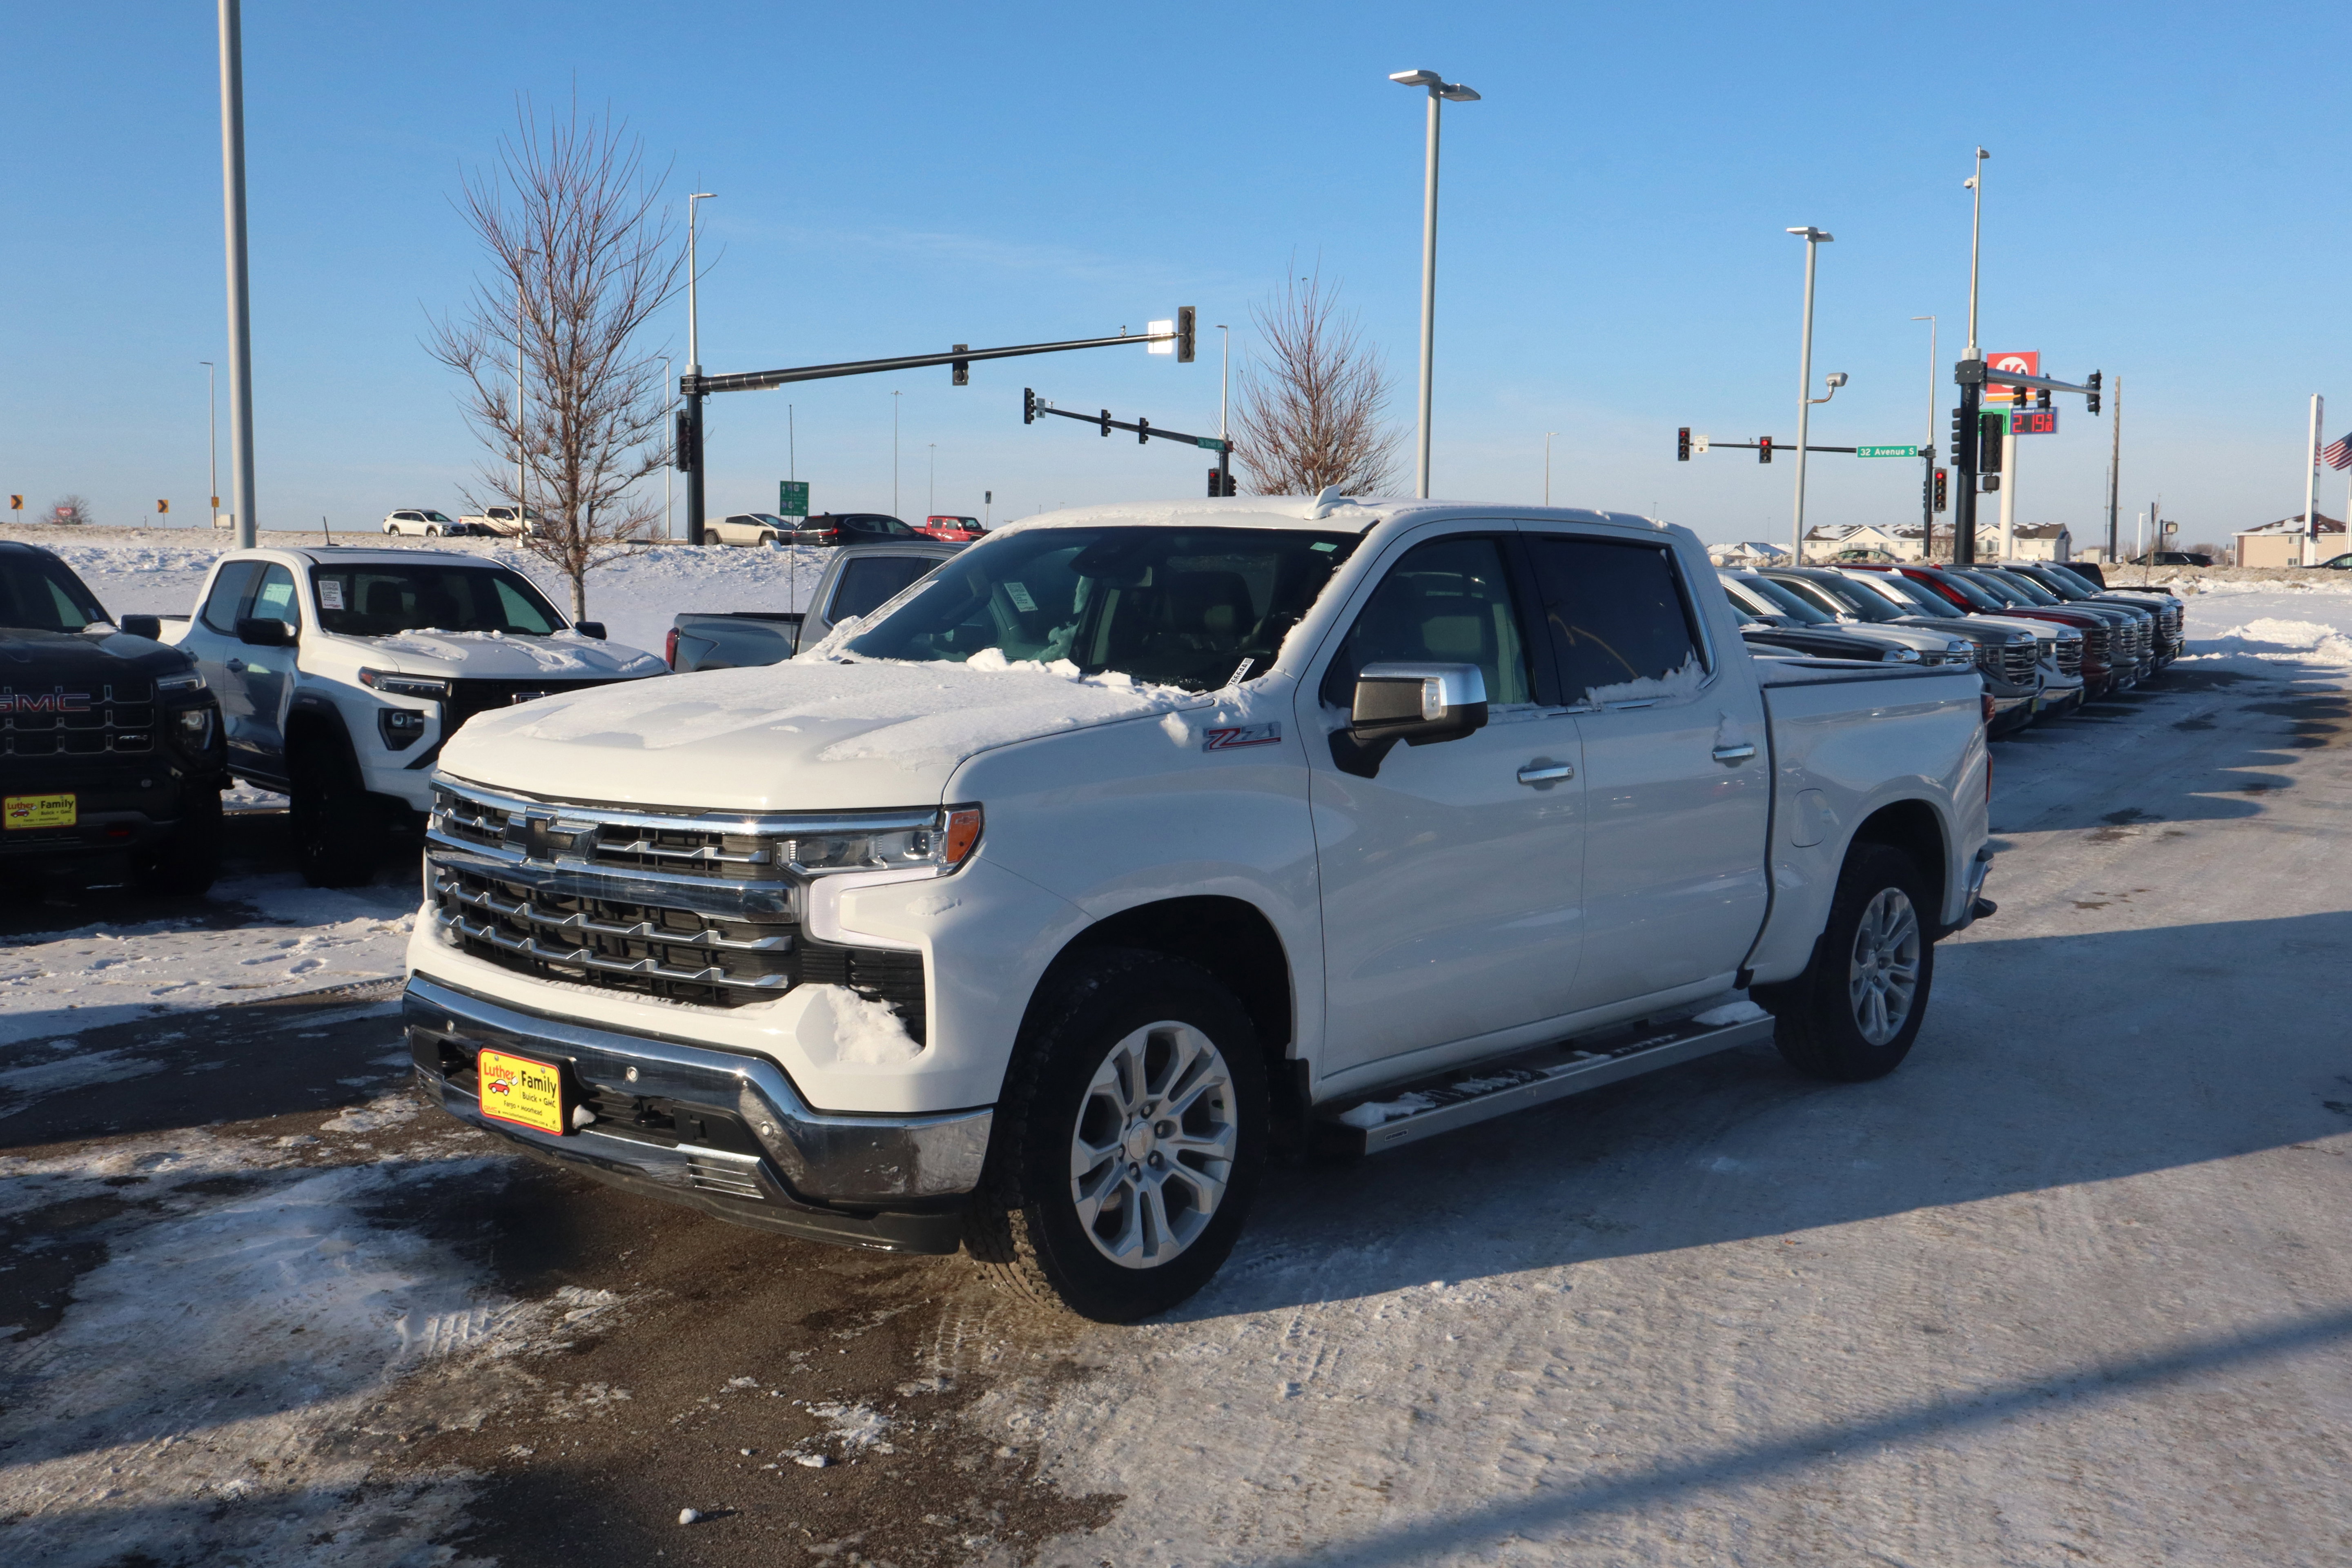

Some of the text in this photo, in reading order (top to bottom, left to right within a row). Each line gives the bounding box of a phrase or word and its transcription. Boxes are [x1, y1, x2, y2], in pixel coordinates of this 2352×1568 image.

[1203, 722, 1281, 752] Z71
[41, 799, 74, 809] Family
[484, 1062, 514, 1080] Luther
[521, 1070, 557, 1098] Family
[504, 1100, 542, 1116] Fargo Moorhead
[522, 1091, 556, 1108] Buick GMC
